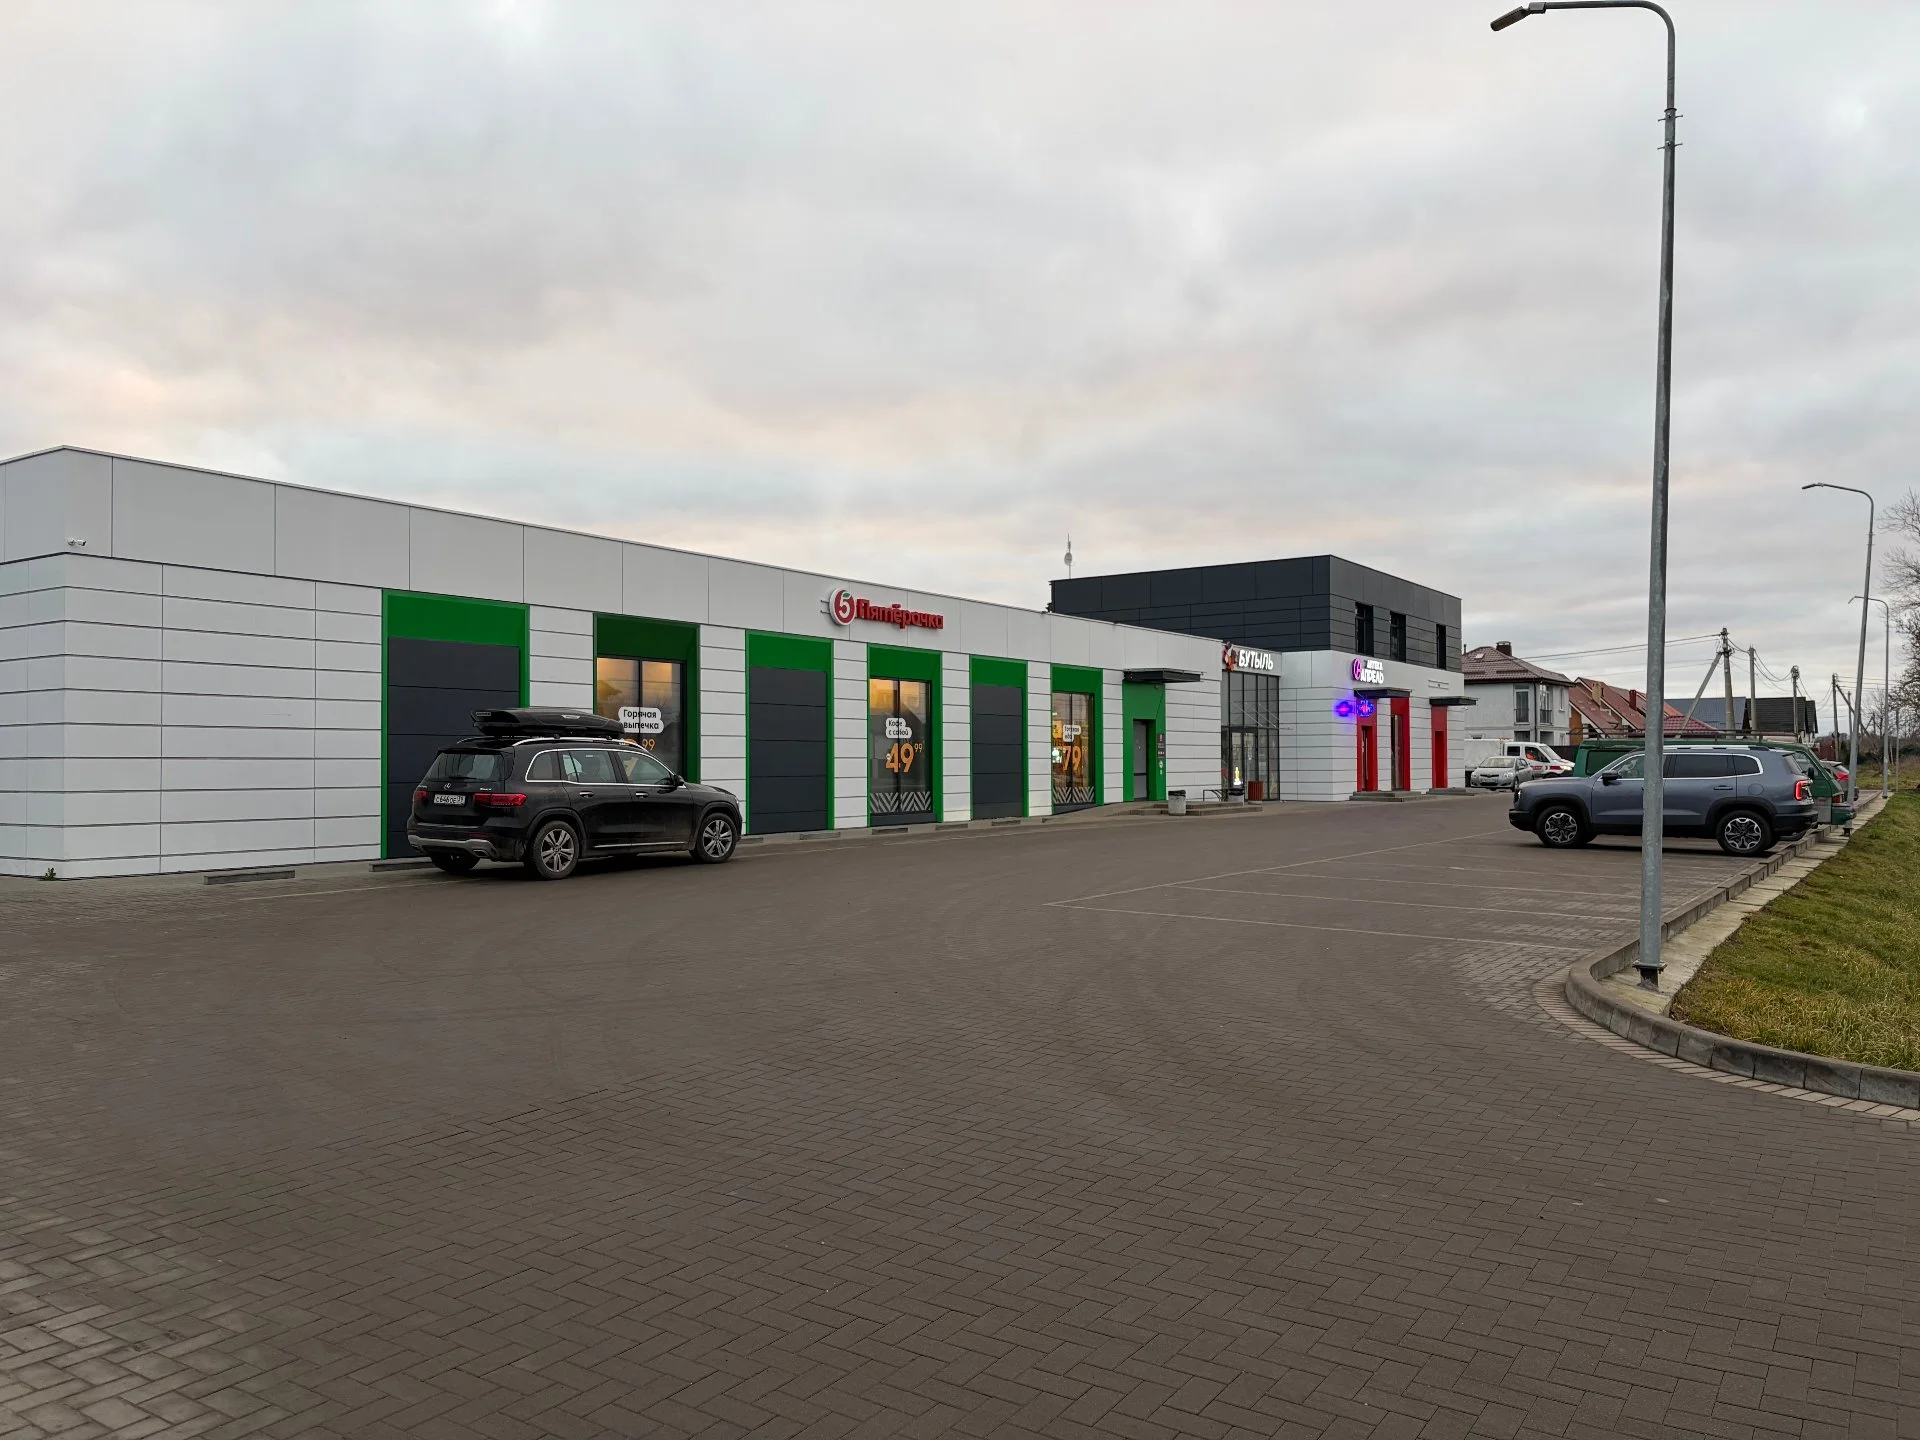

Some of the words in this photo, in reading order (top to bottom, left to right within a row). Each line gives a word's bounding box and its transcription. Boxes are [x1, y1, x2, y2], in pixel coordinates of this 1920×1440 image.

[855, 598, 944, 629] Пятёрочка
[1238, 649, 1274, 670] БУТЫЛЬ
[623, 709, 657, 720] Горячая
[623, 721, 660, 730] выпечка
[885, 743, 915, 773] 49
